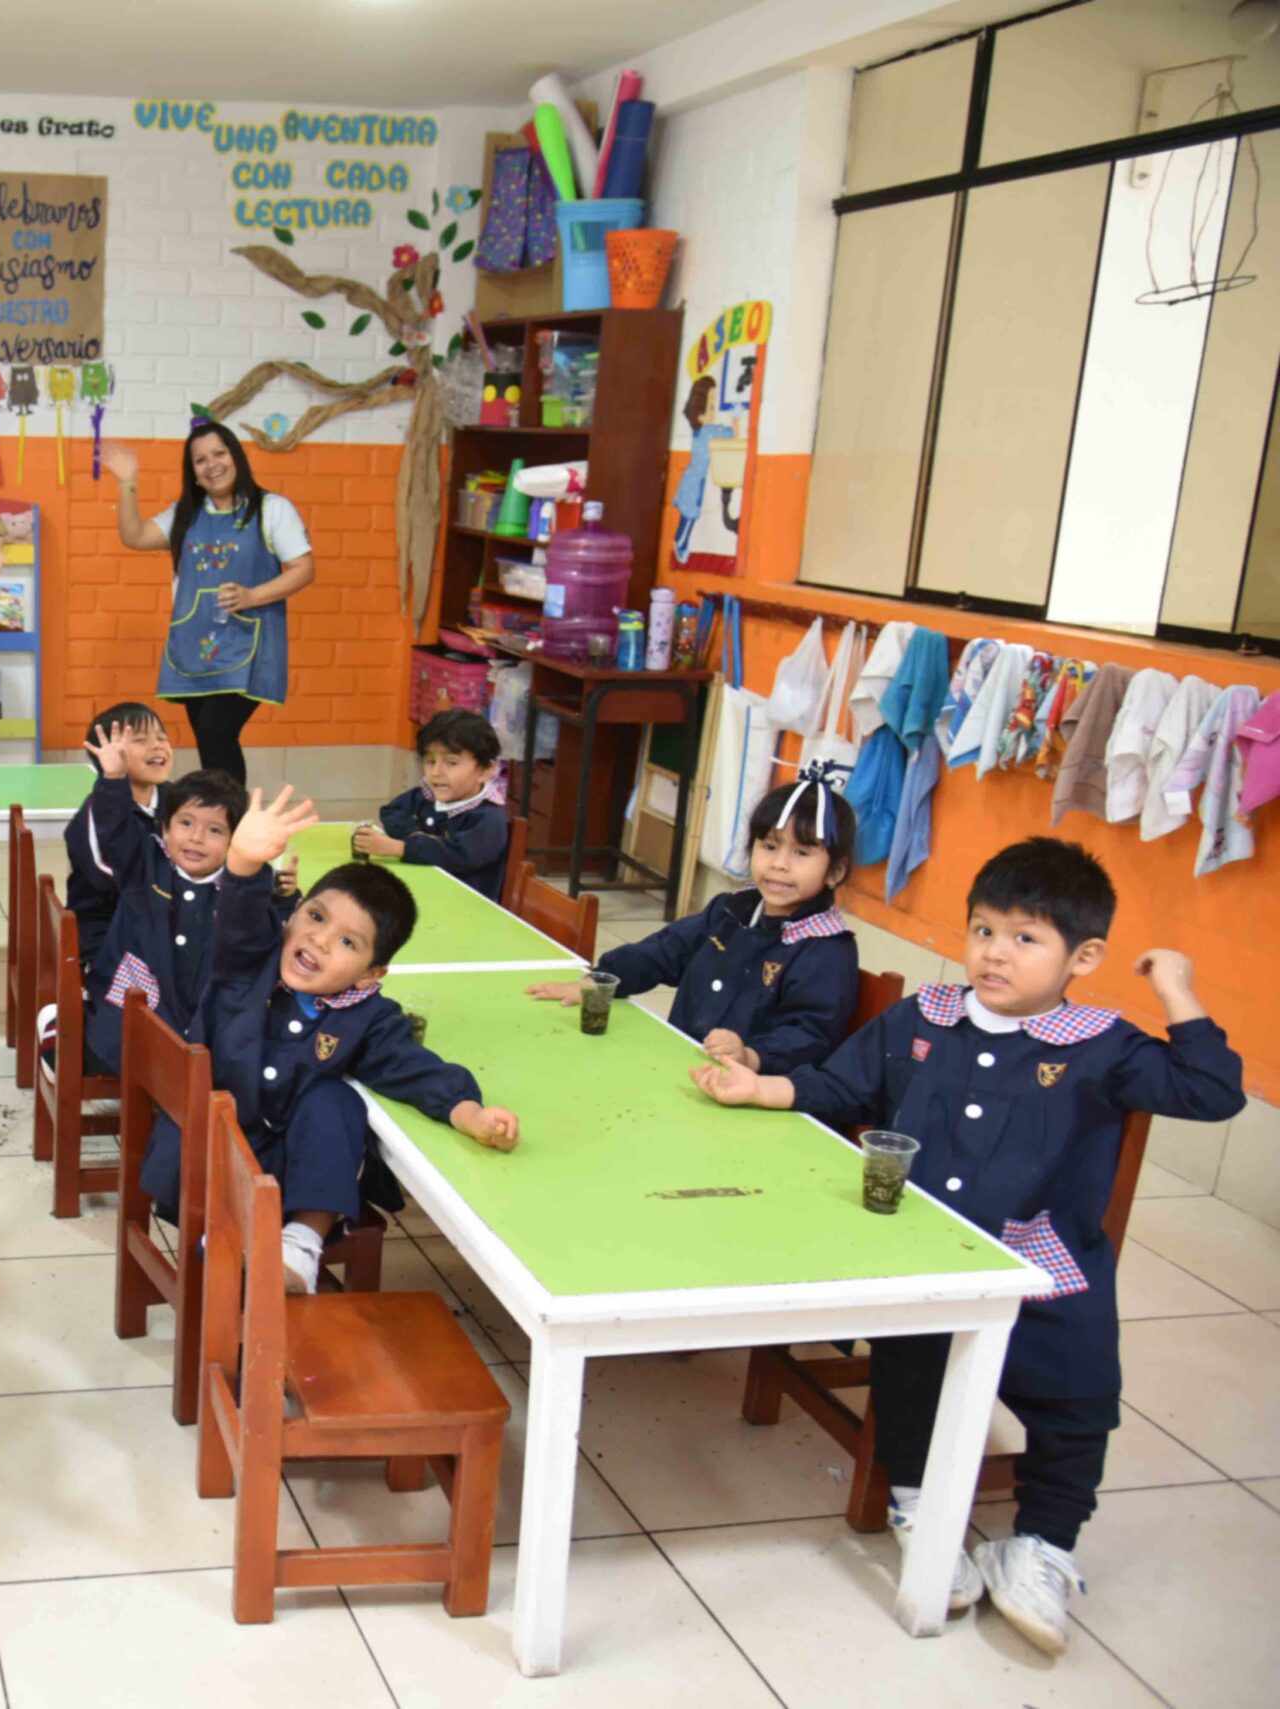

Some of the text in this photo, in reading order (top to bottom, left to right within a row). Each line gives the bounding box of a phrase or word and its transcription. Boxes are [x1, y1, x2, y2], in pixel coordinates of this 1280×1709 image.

[0, 117, 29, 136] es
[37, 116, 116, 139] Grato
[134, 100, 439, 154] VIVE UNA AVENTURA
[230, 160, 410, 192] CON CADA
[234, 197, 373, 229] LECTURA
[12, 229, 53, 250] CON
[696, 300, 764, 375] ASEO
